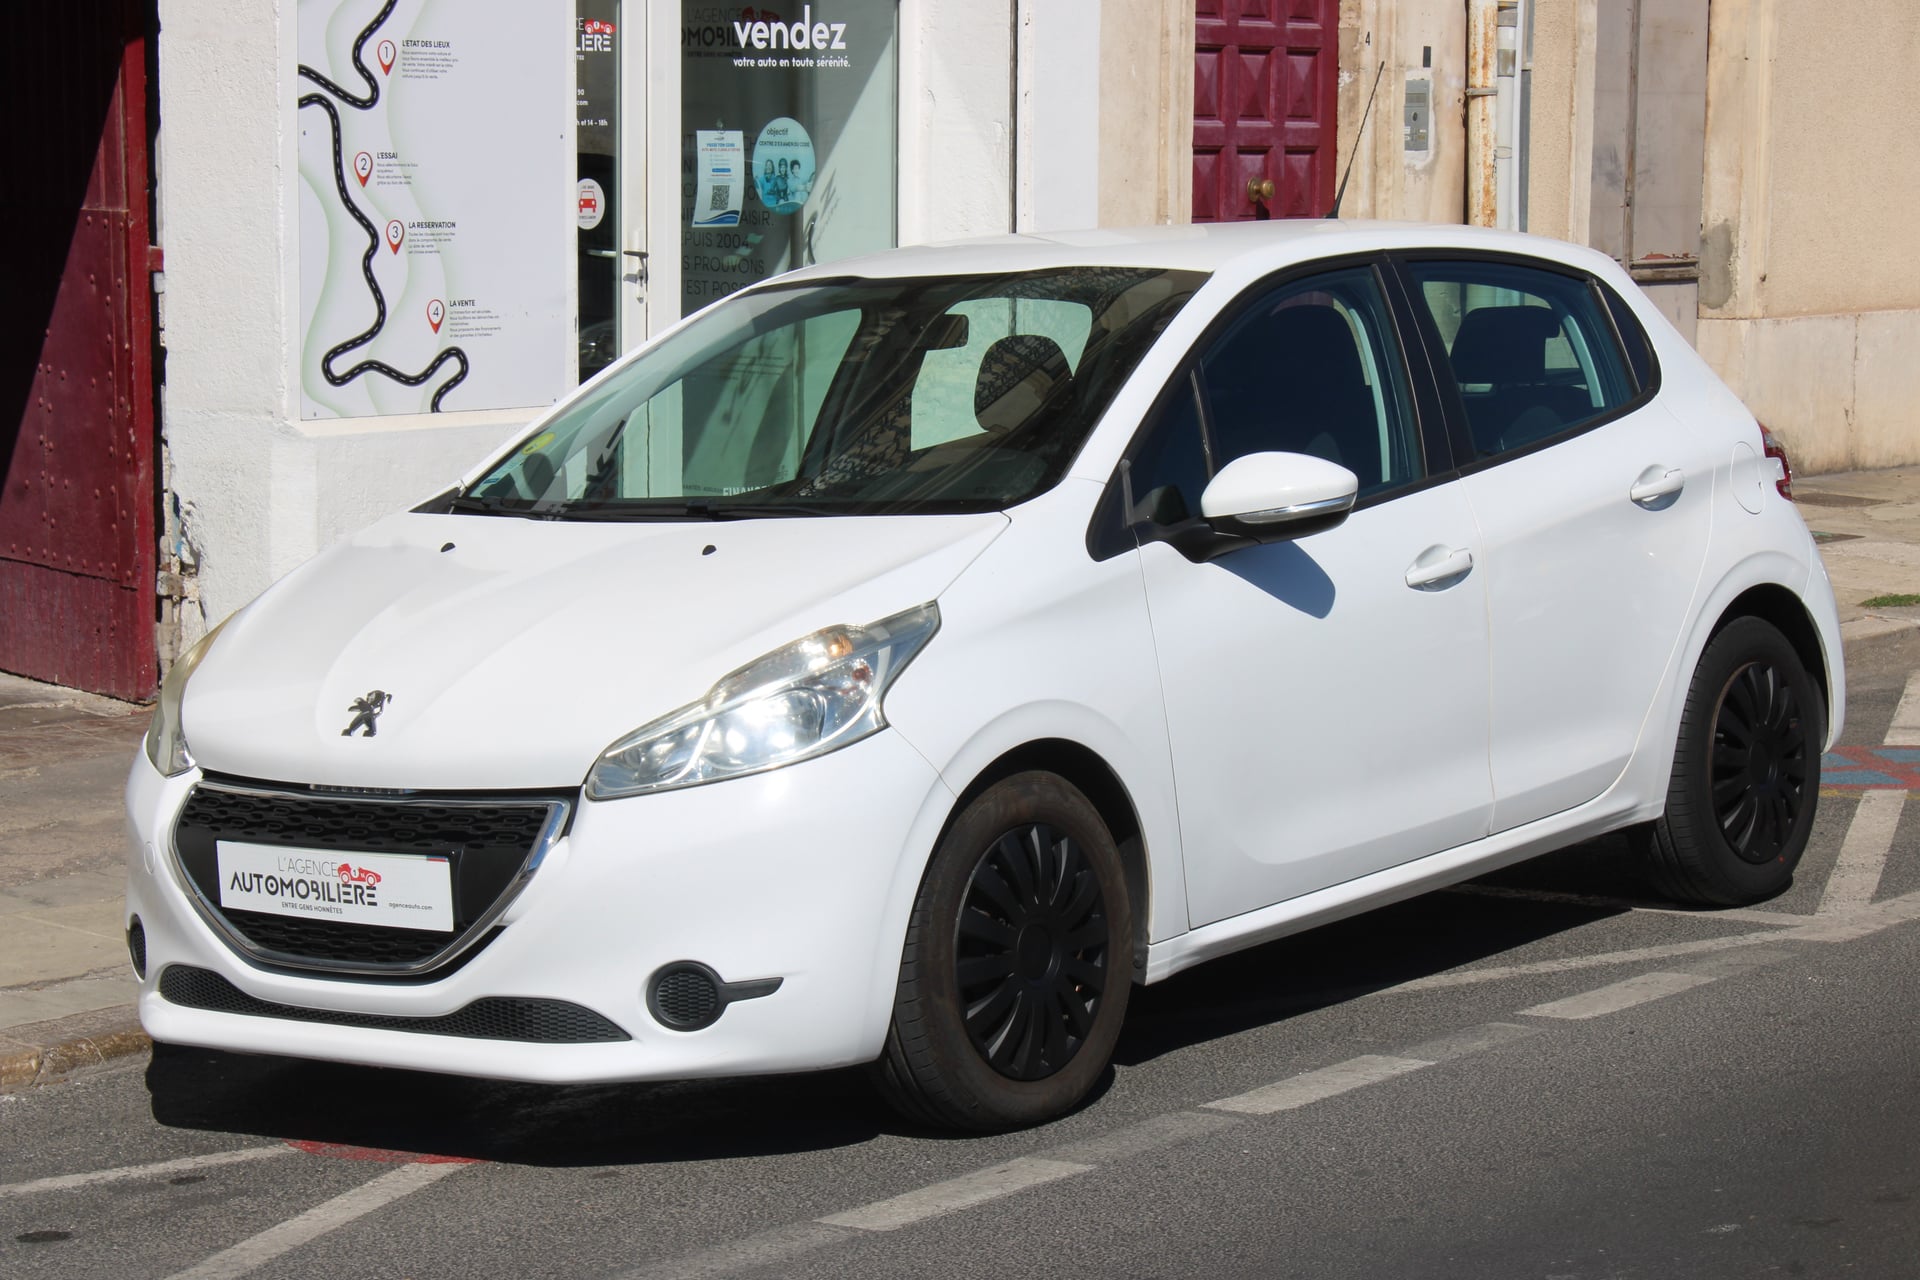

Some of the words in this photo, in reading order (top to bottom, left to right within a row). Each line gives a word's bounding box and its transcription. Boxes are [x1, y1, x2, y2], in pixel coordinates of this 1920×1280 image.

[733, 4, 847, 50] vendez
[420, 40, 433, 48] DES
[433, 41, 451, 49] LIEUX
[384, 46, 389, 59] 1
[733, 57, 755, 67] votre
[758, 57, 777, 67] auto
[779, 59, 790, 67] en
[792, 57, 815, 68] toute
[816, 55, 851, 68] sérénité.
[767, 128, 789, 137] objectif
[377, 152, 398, 160] L'ESSAI
[360, 158, 368, 171] 2
[392, 226, 399, 239] 3
[684, 231, 713, 249] PUIS
[693, 255, 765, 275] PROUVONS
[457, 299, 476, 307] VENTE
[433, 306, 440, 318] 4
[277, 855, 339, 878] L'AGENCE
[281, 901, 298, 909] ENTRE
[298, 903, 314, 912] GENS
[313, 905, 343, 915] HONNÊTES
[388, 902, 433, 911] agenceauto.com
